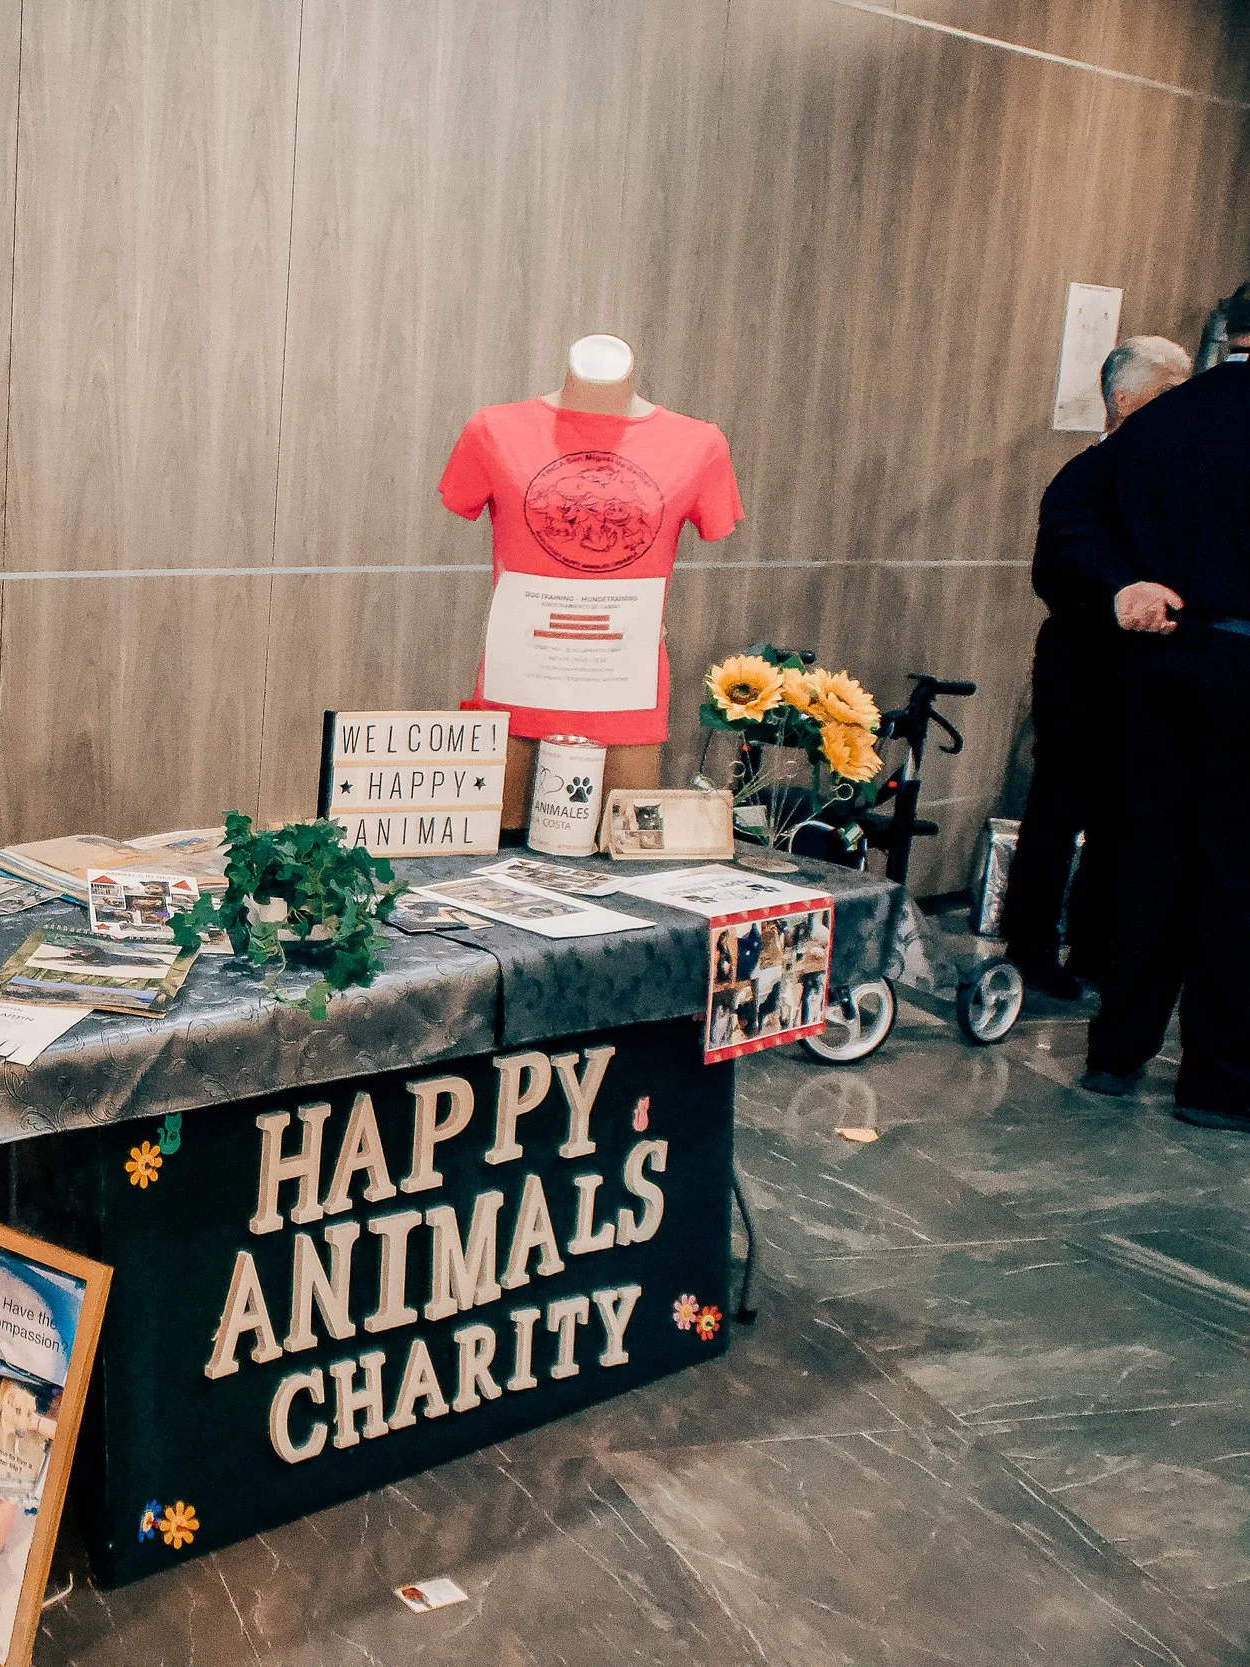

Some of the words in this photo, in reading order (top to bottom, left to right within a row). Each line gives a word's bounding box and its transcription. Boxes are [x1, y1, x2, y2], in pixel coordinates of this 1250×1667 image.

[526, 591, 539, 599] DOG
[343, 723, 496, 753] WELCOME!
[368, 771, 467, 800] HAPPY
[534, 801, 590, 819] ANIMALES
[543, 818, 571, 829] COSTA
[354, 816, 473, 847] ANIMAL
[250, 1046, 615, 1235] HAPPY
[205, 1139, 668, 1379] ANIMALS
[2, 1296, 35, 1321] Have
[38, 1311, 57, 1330] the
[269, 1286, 642, 1464] CHARITY
